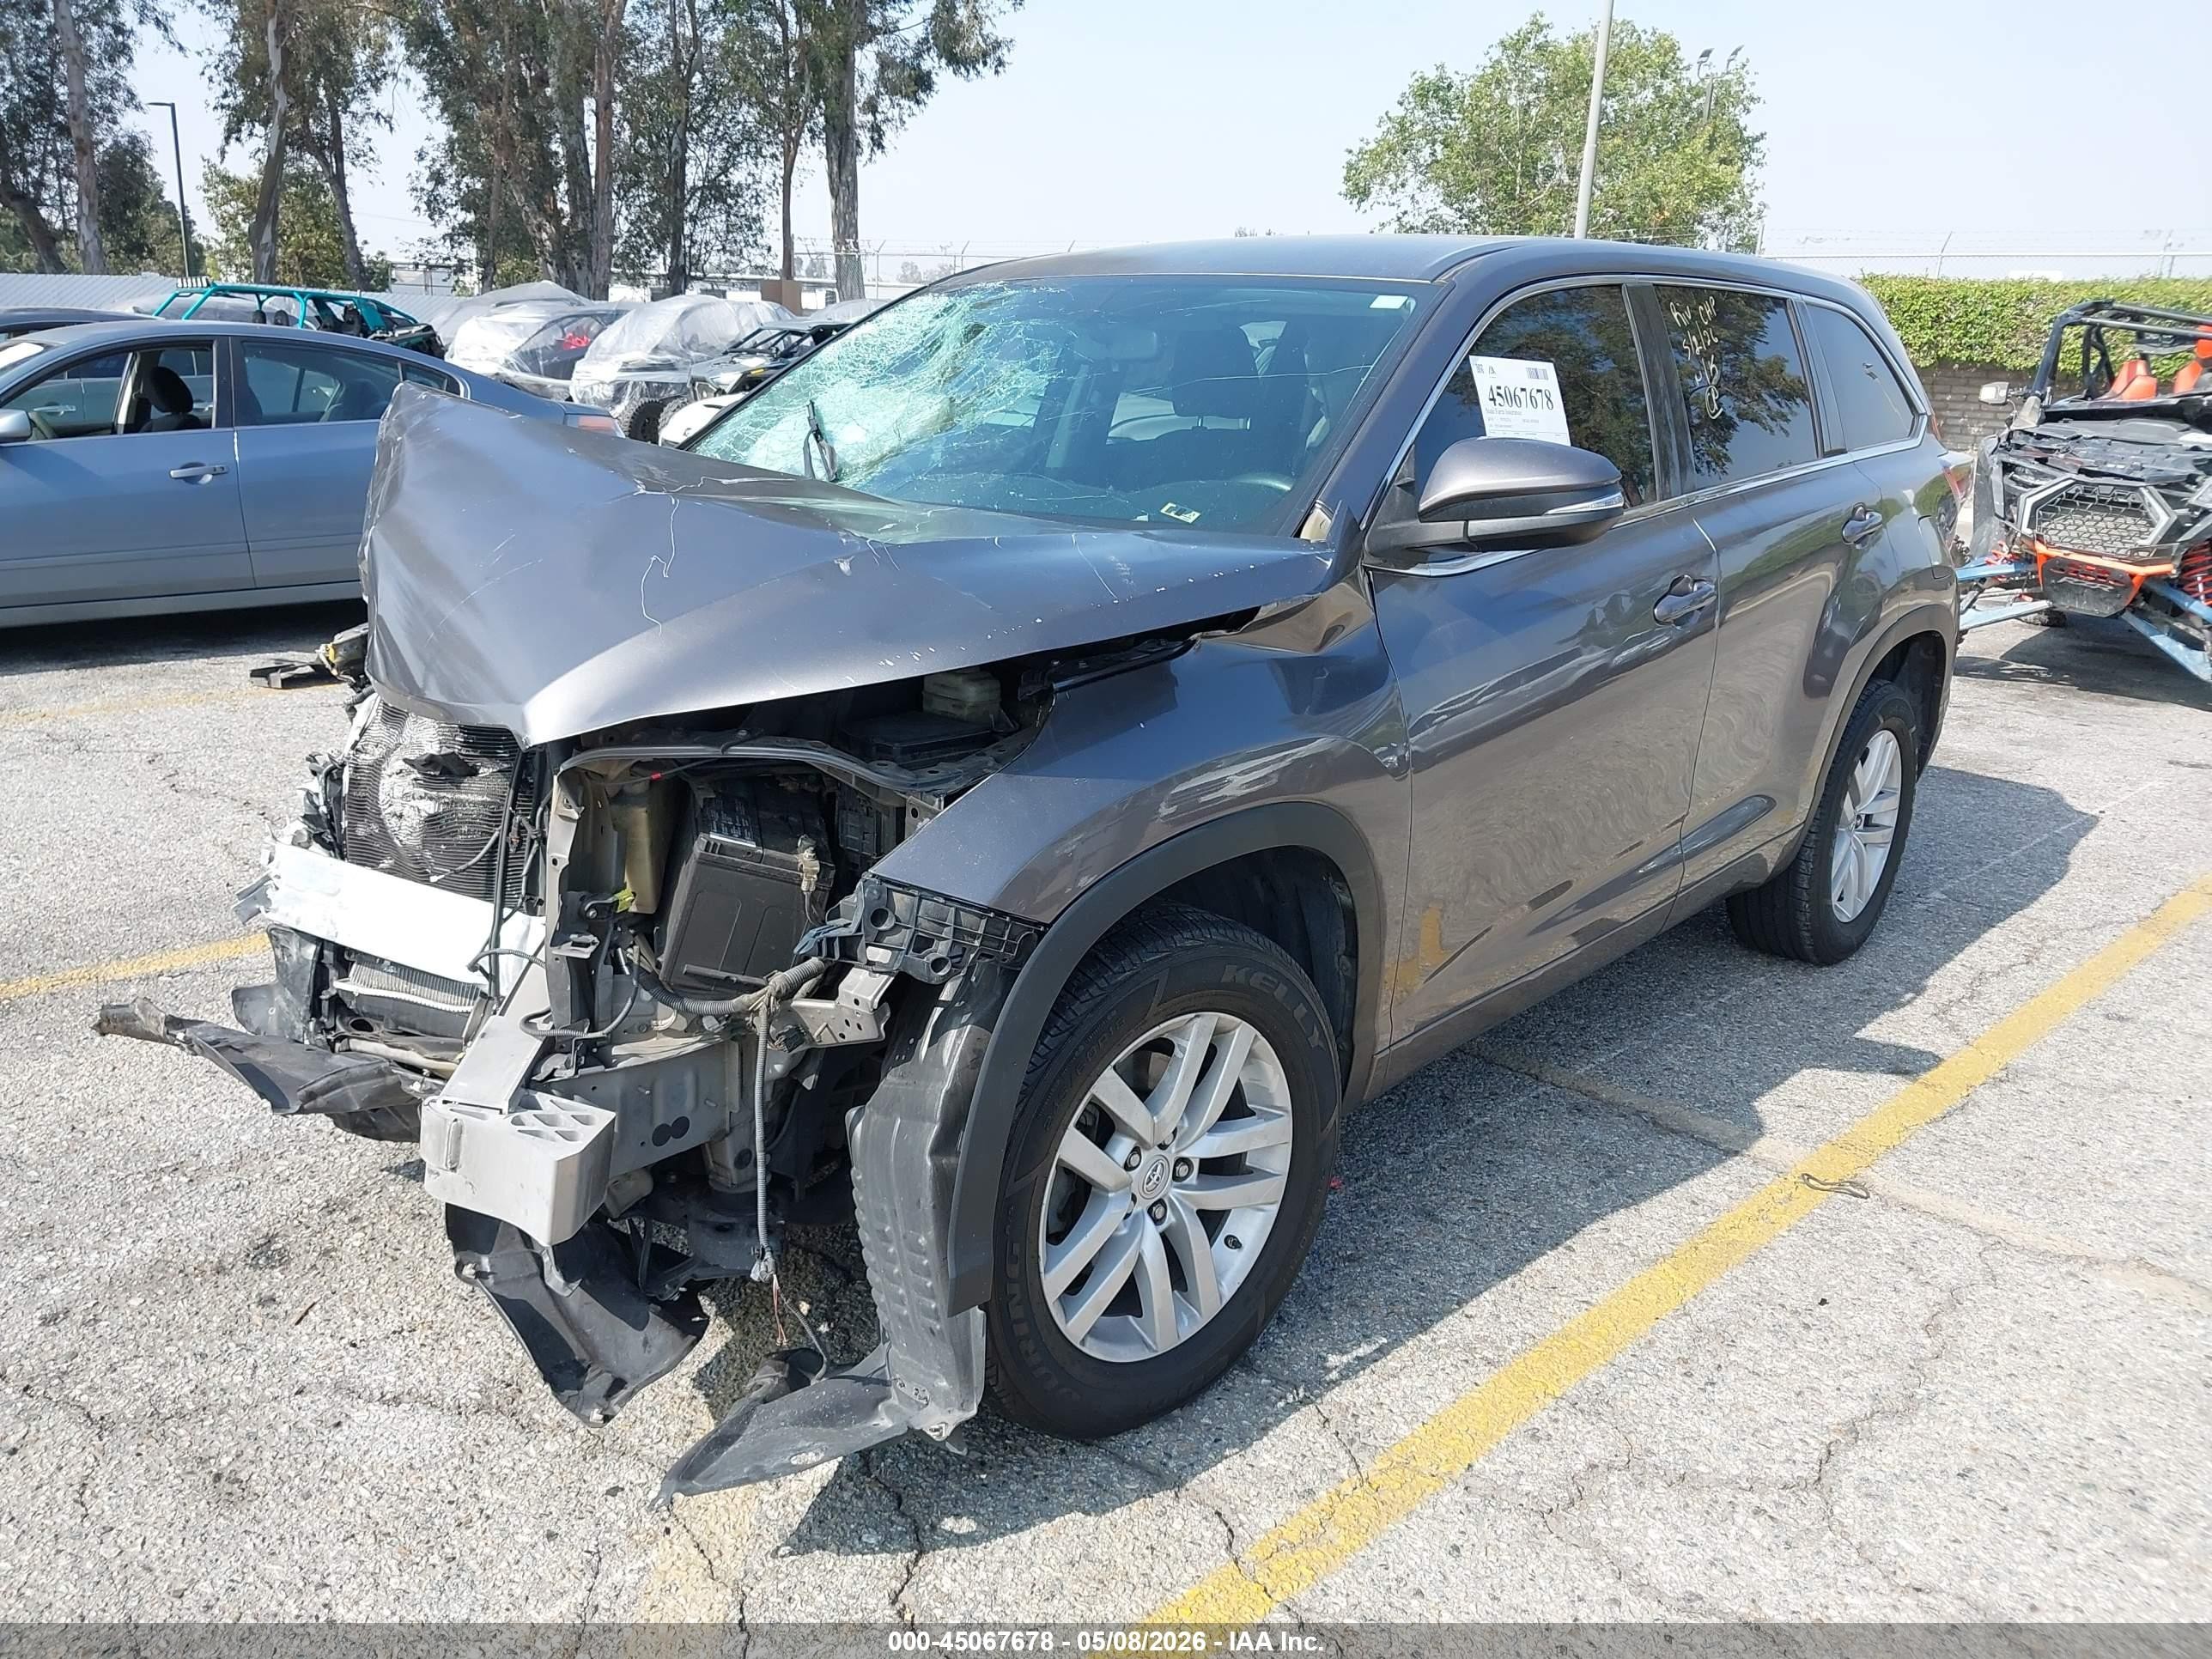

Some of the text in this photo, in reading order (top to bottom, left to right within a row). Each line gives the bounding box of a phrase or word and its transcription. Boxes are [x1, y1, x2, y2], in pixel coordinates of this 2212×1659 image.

[1698, 295, 1717, 325] CHP
[1488, 385, 1554, 410] 45067678
[1221, 963, 1327, 1050] KELLY
